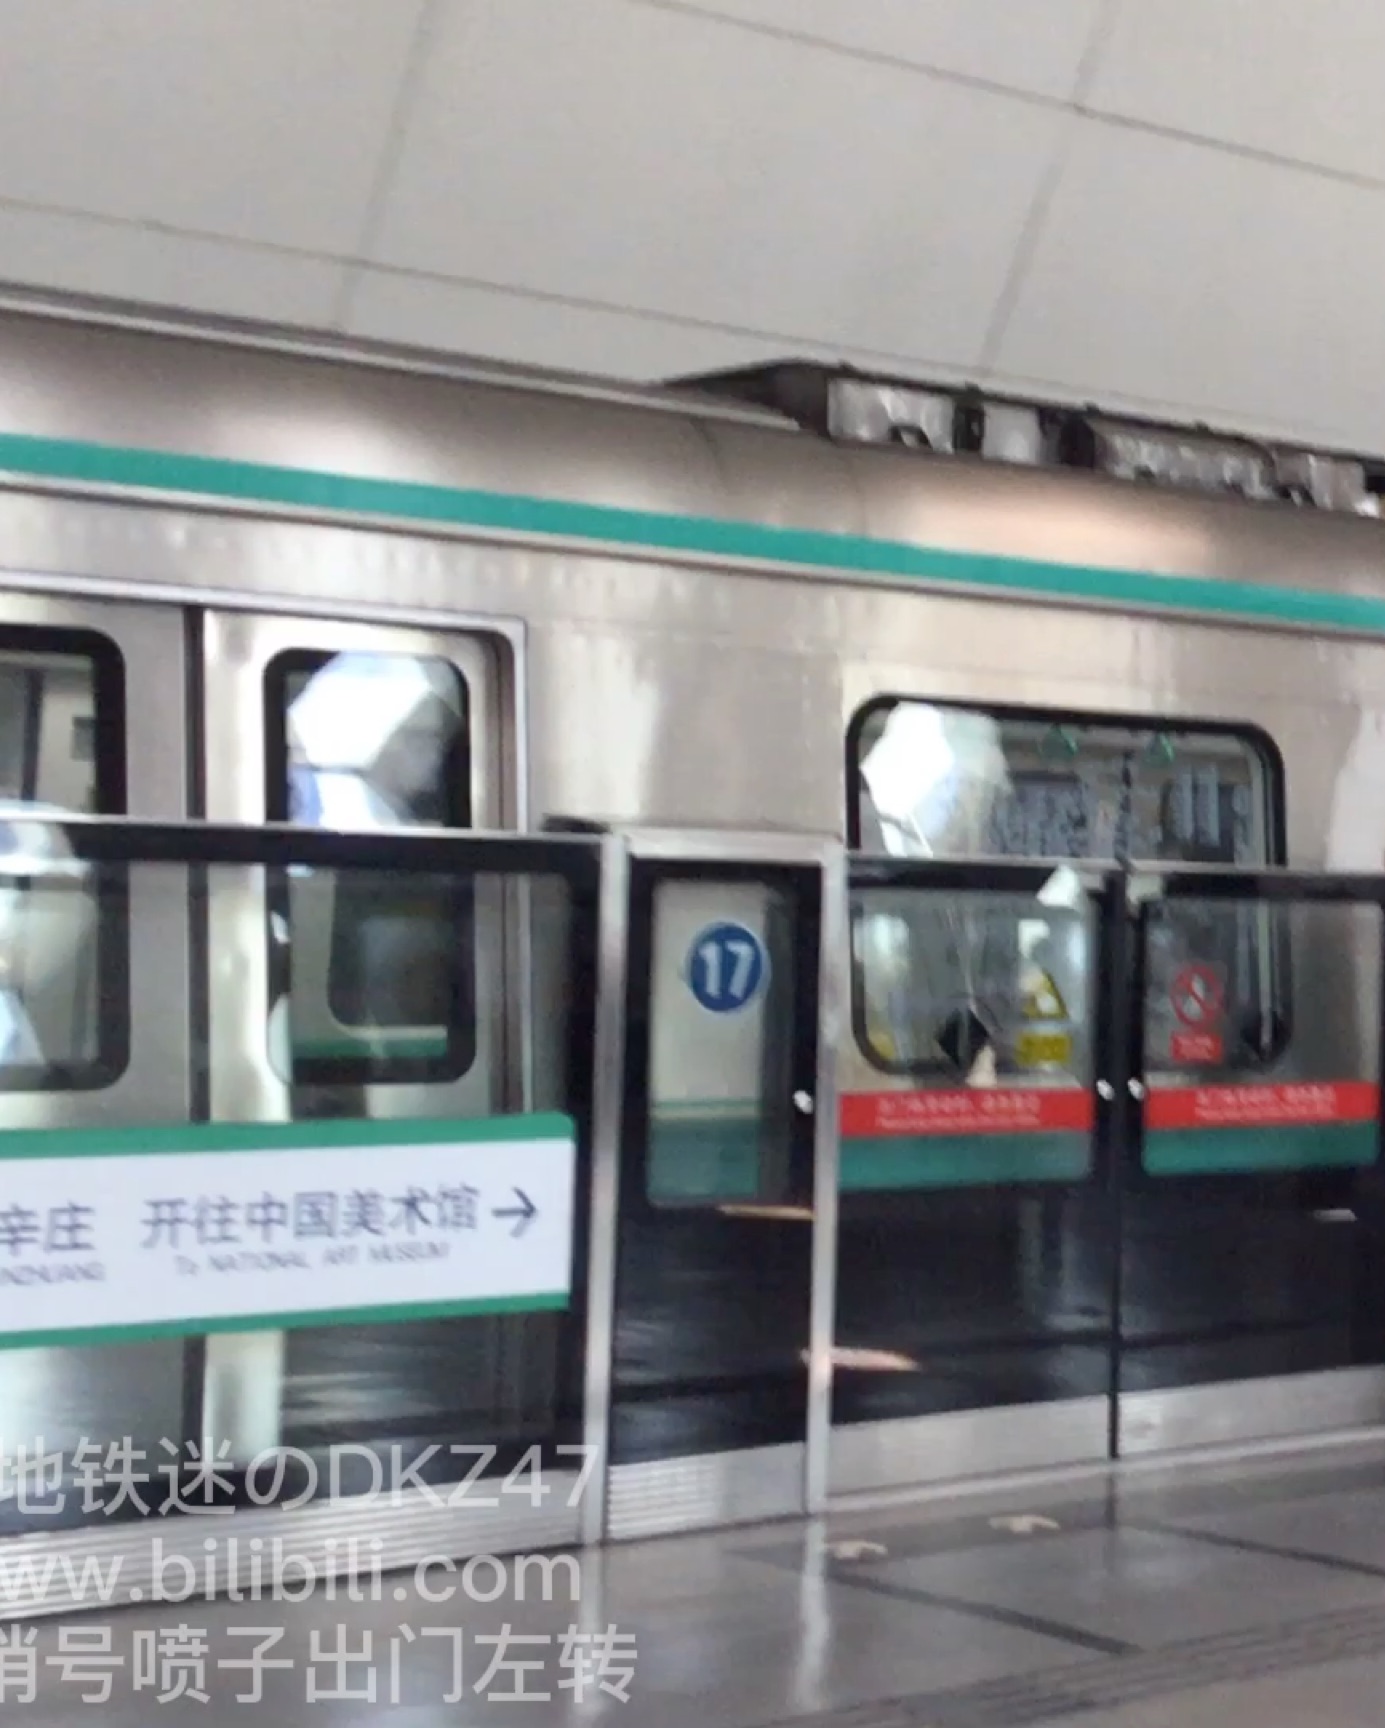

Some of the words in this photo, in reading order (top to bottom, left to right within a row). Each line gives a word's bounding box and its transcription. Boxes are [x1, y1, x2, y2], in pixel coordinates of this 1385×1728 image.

[700, 939, 755, 999] 17
[141, 1183, 479, 1249] 开往中国美术馆
